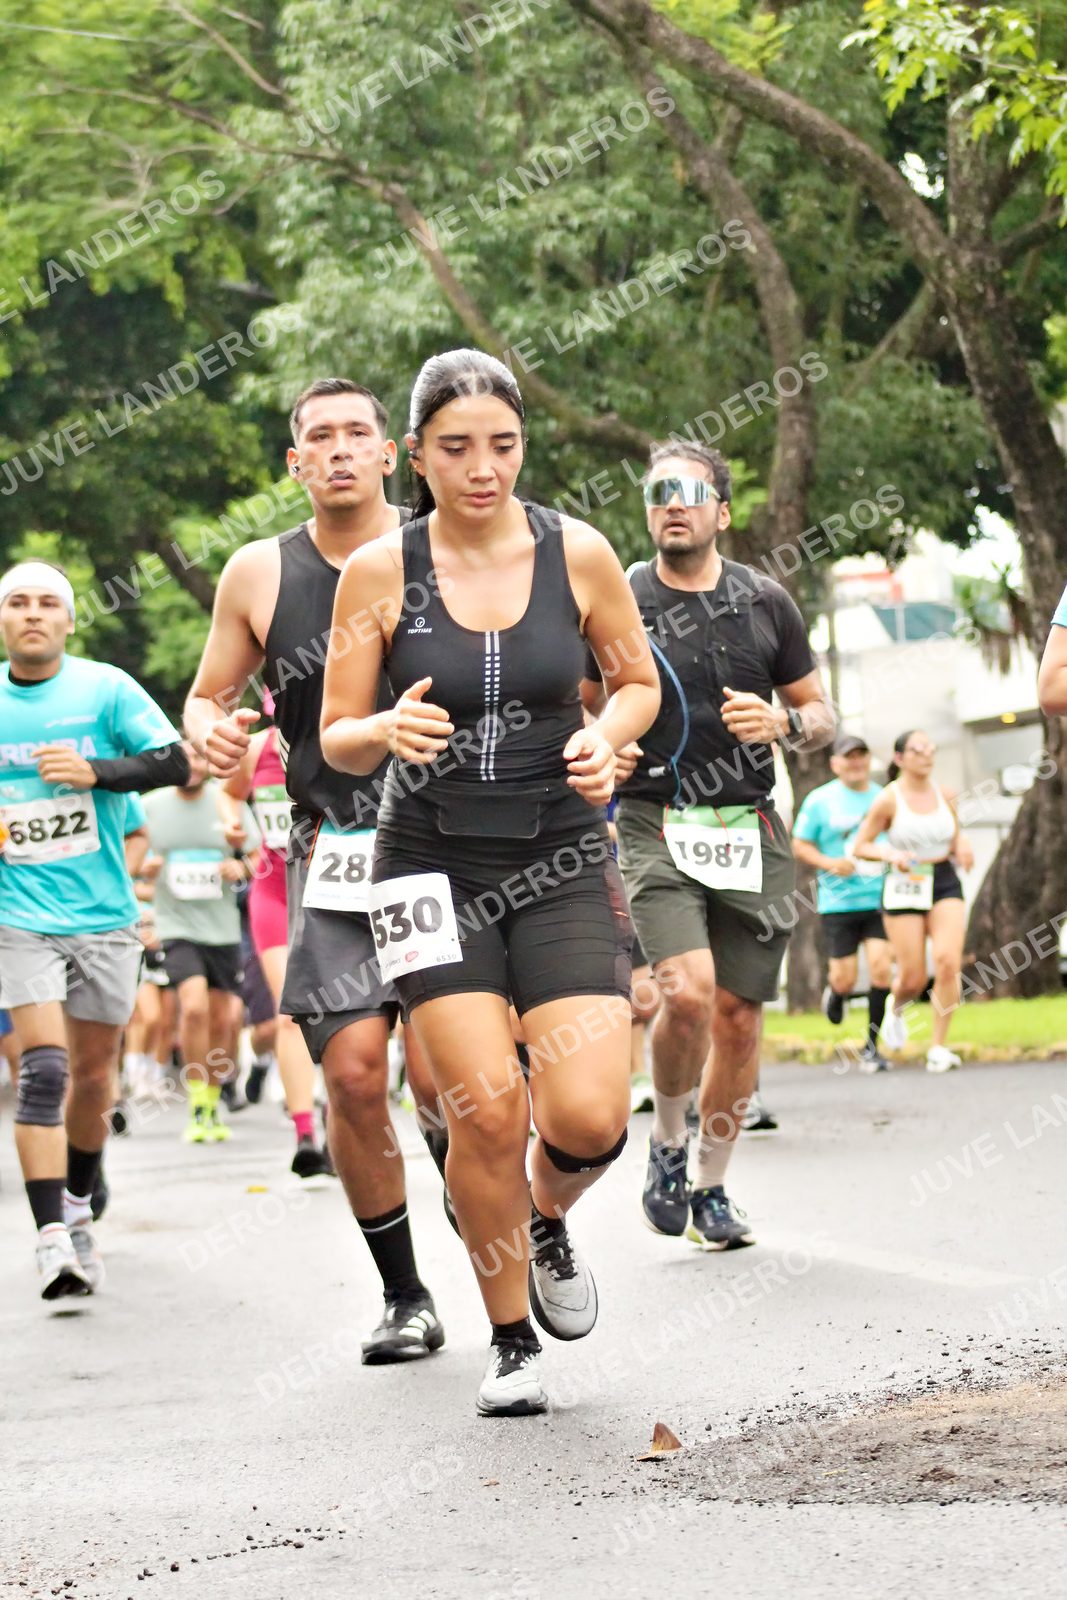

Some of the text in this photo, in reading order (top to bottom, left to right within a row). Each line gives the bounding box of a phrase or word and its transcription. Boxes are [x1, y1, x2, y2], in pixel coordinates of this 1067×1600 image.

[407, 627, 433, 635] TOPTIME
[8, 811, 90, 845] 6822
[318, 852, 372, 884] 28
[675, 841, 753, 868] 1987
